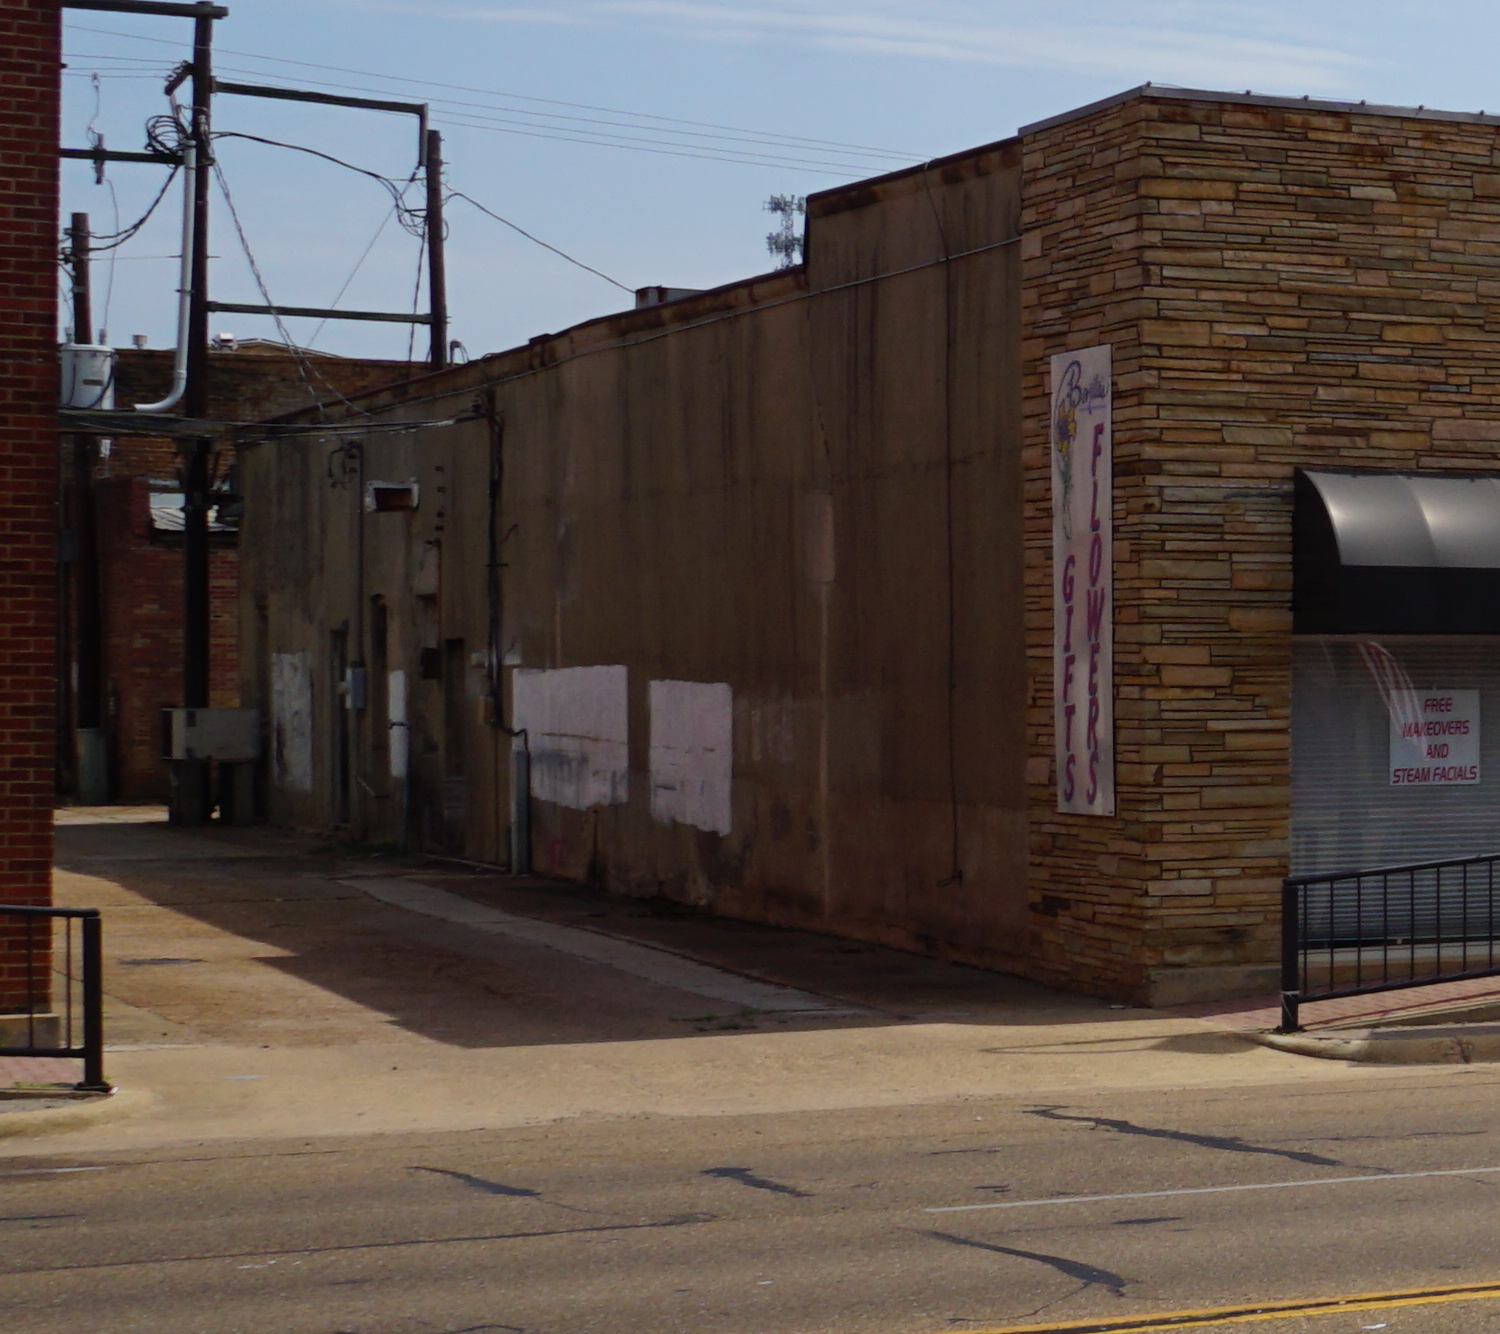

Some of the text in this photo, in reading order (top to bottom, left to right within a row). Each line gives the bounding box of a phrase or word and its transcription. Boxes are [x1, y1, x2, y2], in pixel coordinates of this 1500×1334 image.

[1087, 423, 1104, 806] FLOWERS
[1062, 554, 1076, 805] GIFTS
[1424, 697, 1453, 713] FREE
[1402, 719, 1470, 738] MAKEOVERS
[1426, 743, 1450, 759] AND
[1392, 765, 1478, 784] STEAM FACIALS
